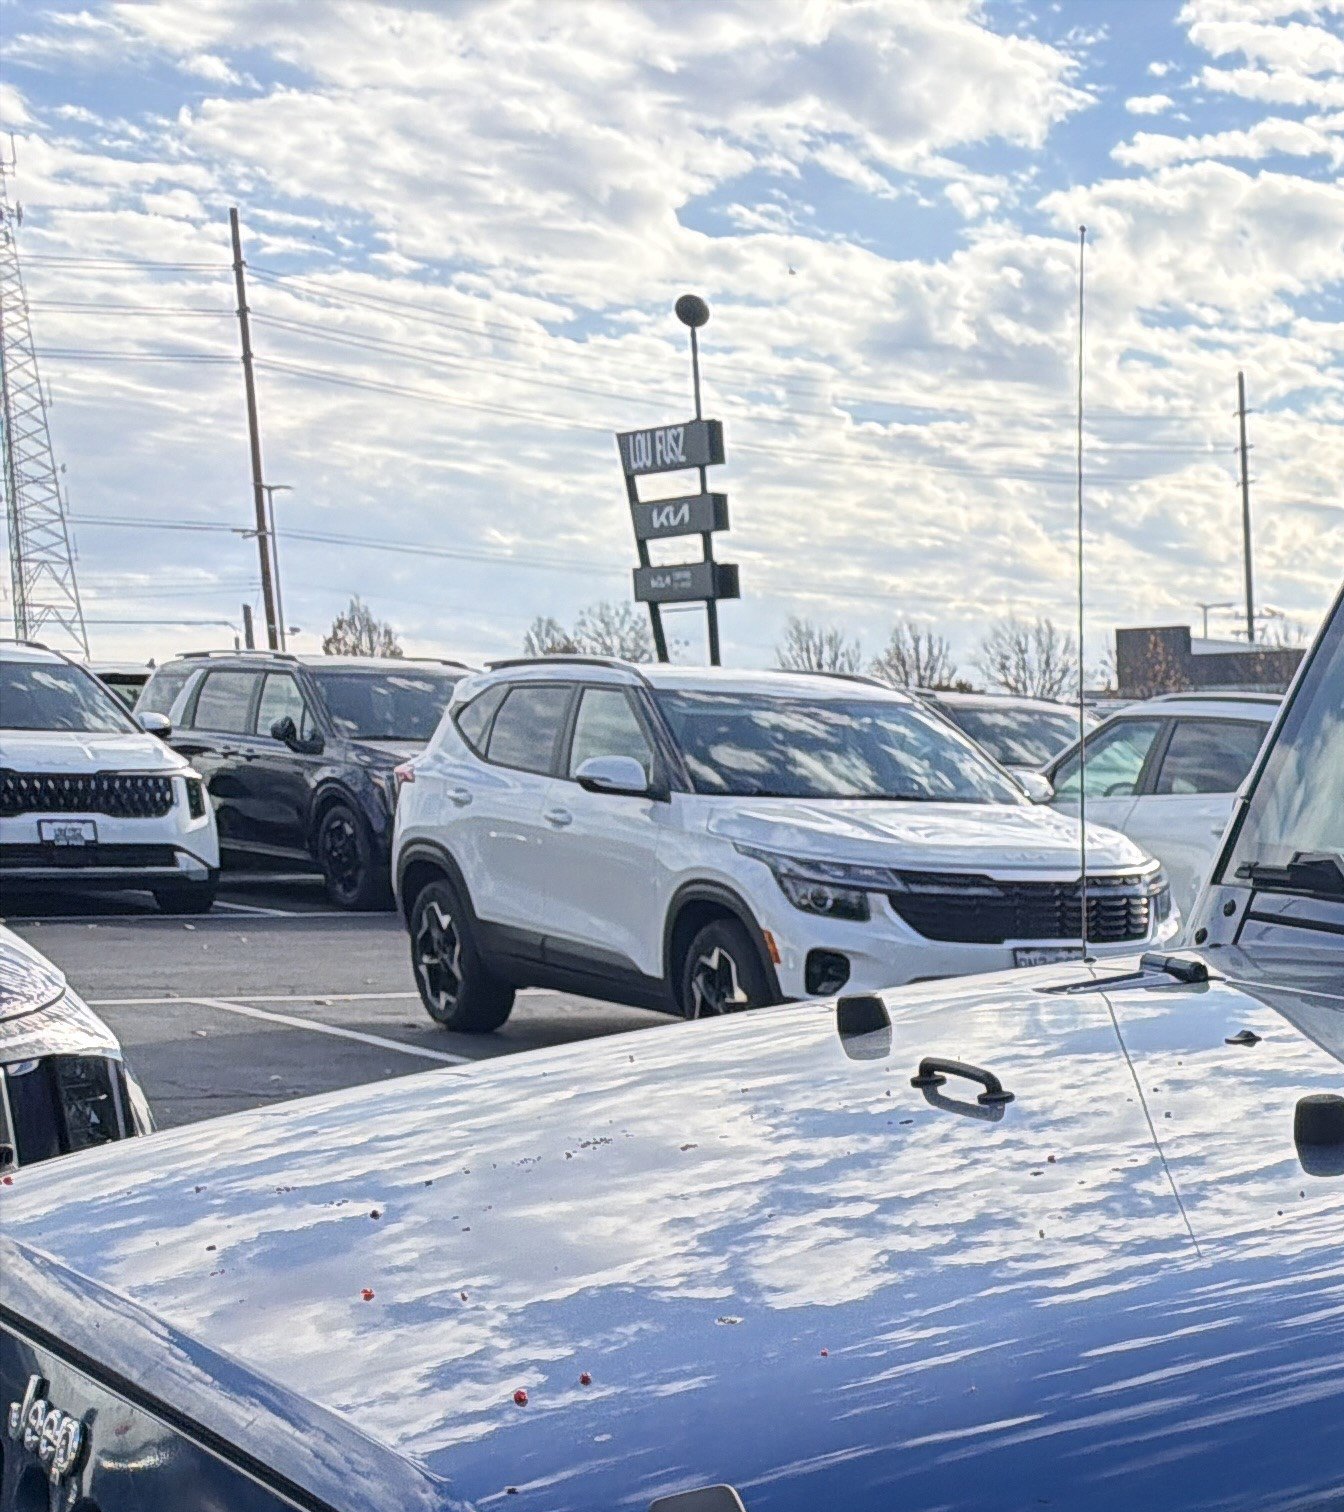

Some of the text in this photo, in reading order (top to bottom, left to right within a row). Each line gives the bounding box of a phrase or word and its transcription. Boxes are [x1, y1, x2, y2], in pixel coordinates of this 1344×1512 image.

[628, 426, 687, 470] LOU FUSZ
[652, 502, 690, 528] KIA
[8, 1374, 90, 1486] Jeep
